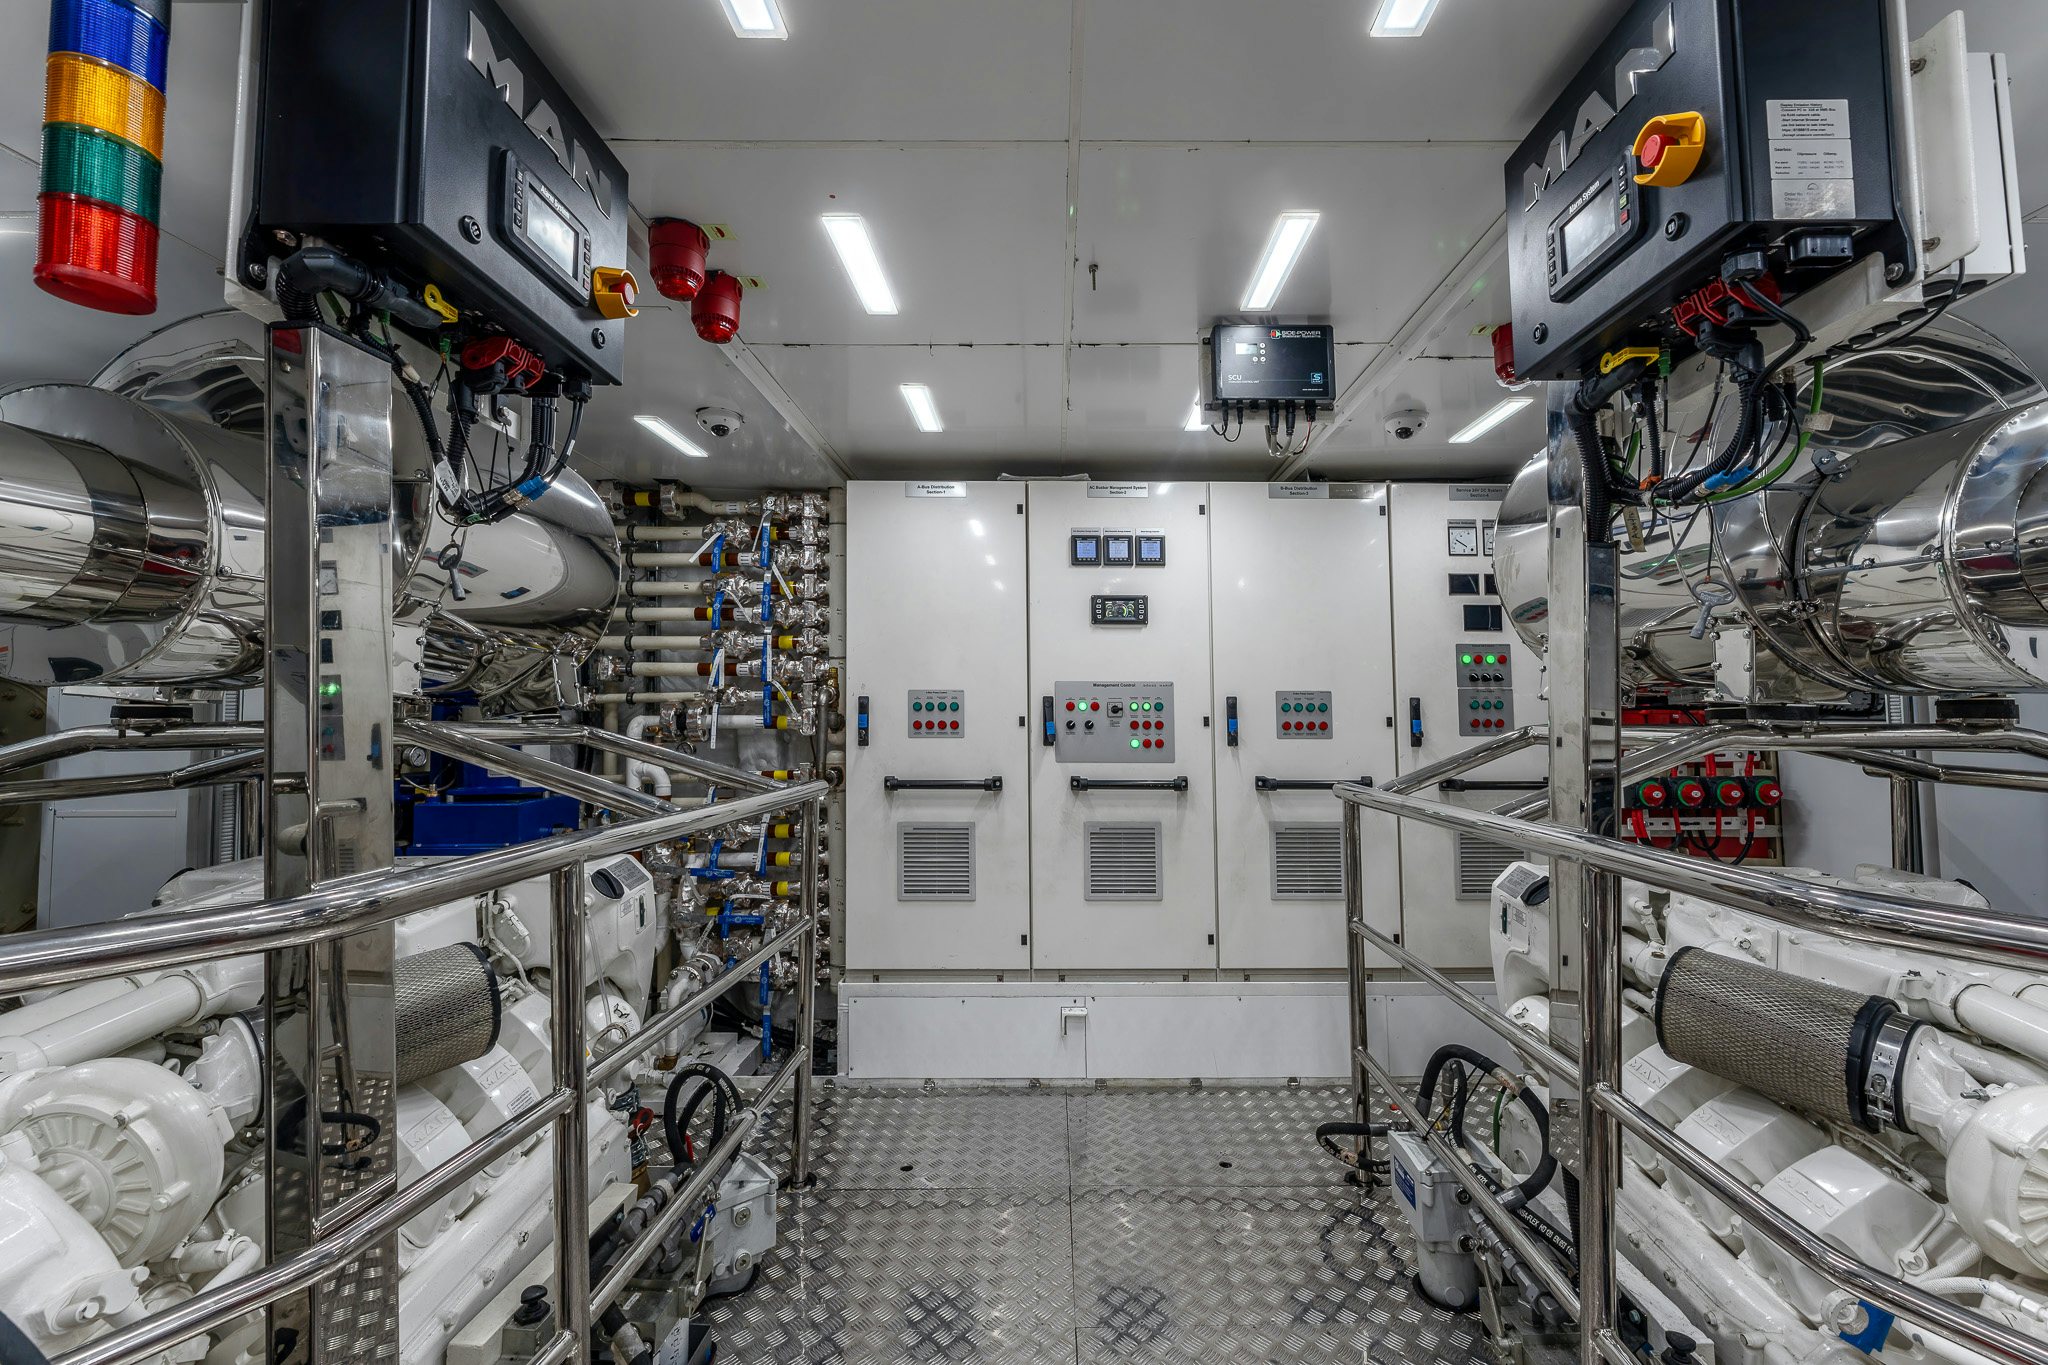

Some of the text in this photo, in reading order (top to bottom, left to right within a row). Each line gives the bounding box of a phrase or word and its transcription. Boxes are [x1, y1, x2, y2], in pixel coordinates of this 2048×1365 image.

[467, 10, 611, 220] MAN
[1523, 2, 1676, 212] MAN
[554, 199, 570, 220] System
[1569, 180, 1600, 214] Alarm System
[480, 1059, 518, 1089] MAN
[1628, 1057, 1666, 1088] MAN
[406, 1109, 452, 1148] MAN
[1695, 1108, 1743, 1145] MAN
[1779, 1171, 1839, 1217] MAN
